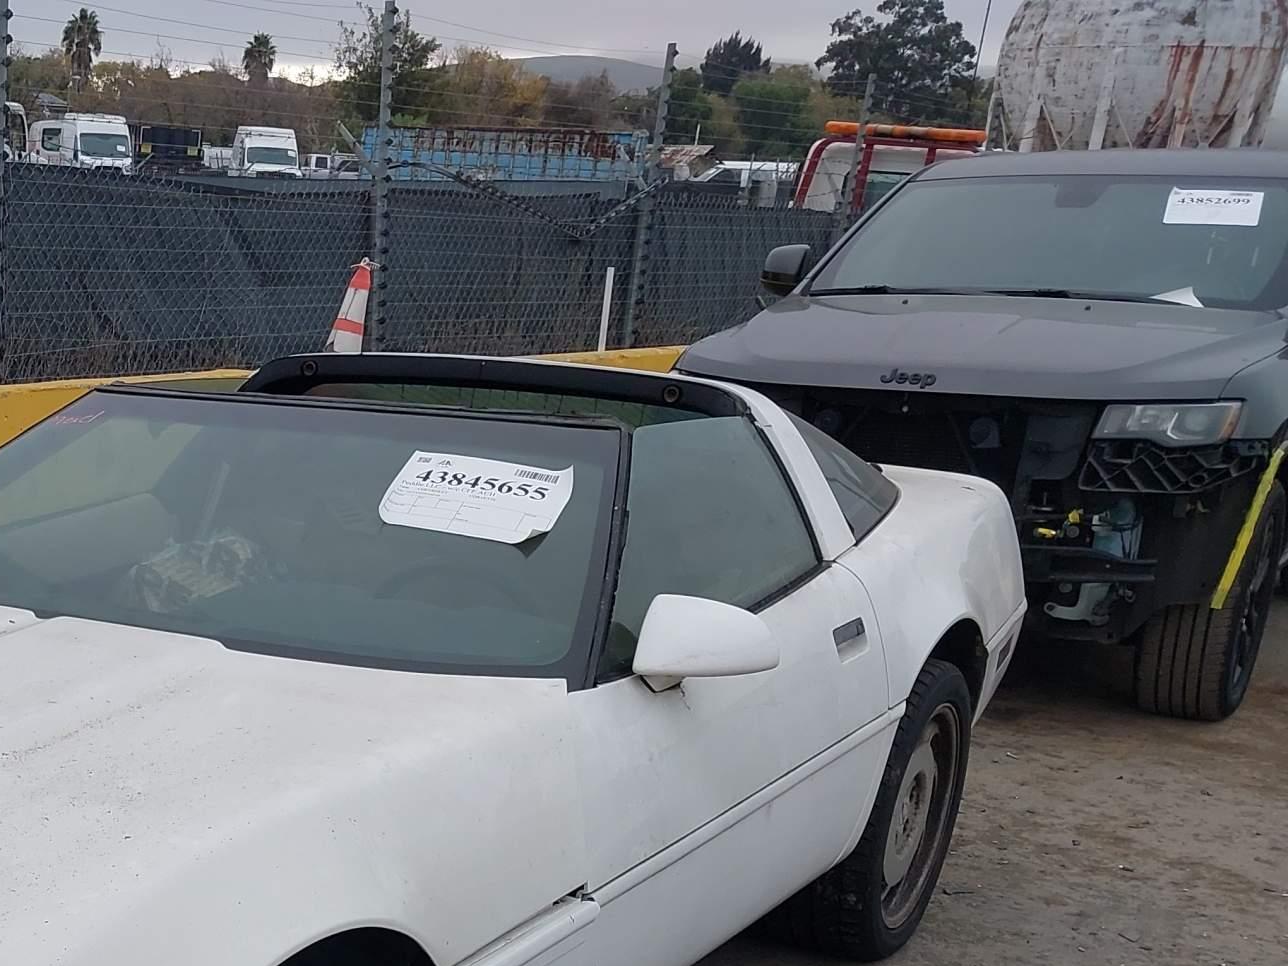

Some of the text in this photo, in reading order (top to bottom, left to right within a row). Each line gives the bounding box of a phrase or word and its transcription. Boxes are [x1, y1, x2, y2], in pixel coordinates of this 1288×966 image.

[1177, 197, 1250, 205] 43852699
[879, 368, 937, 390] Jeep
[415, 469, 549, 500] 43845655
